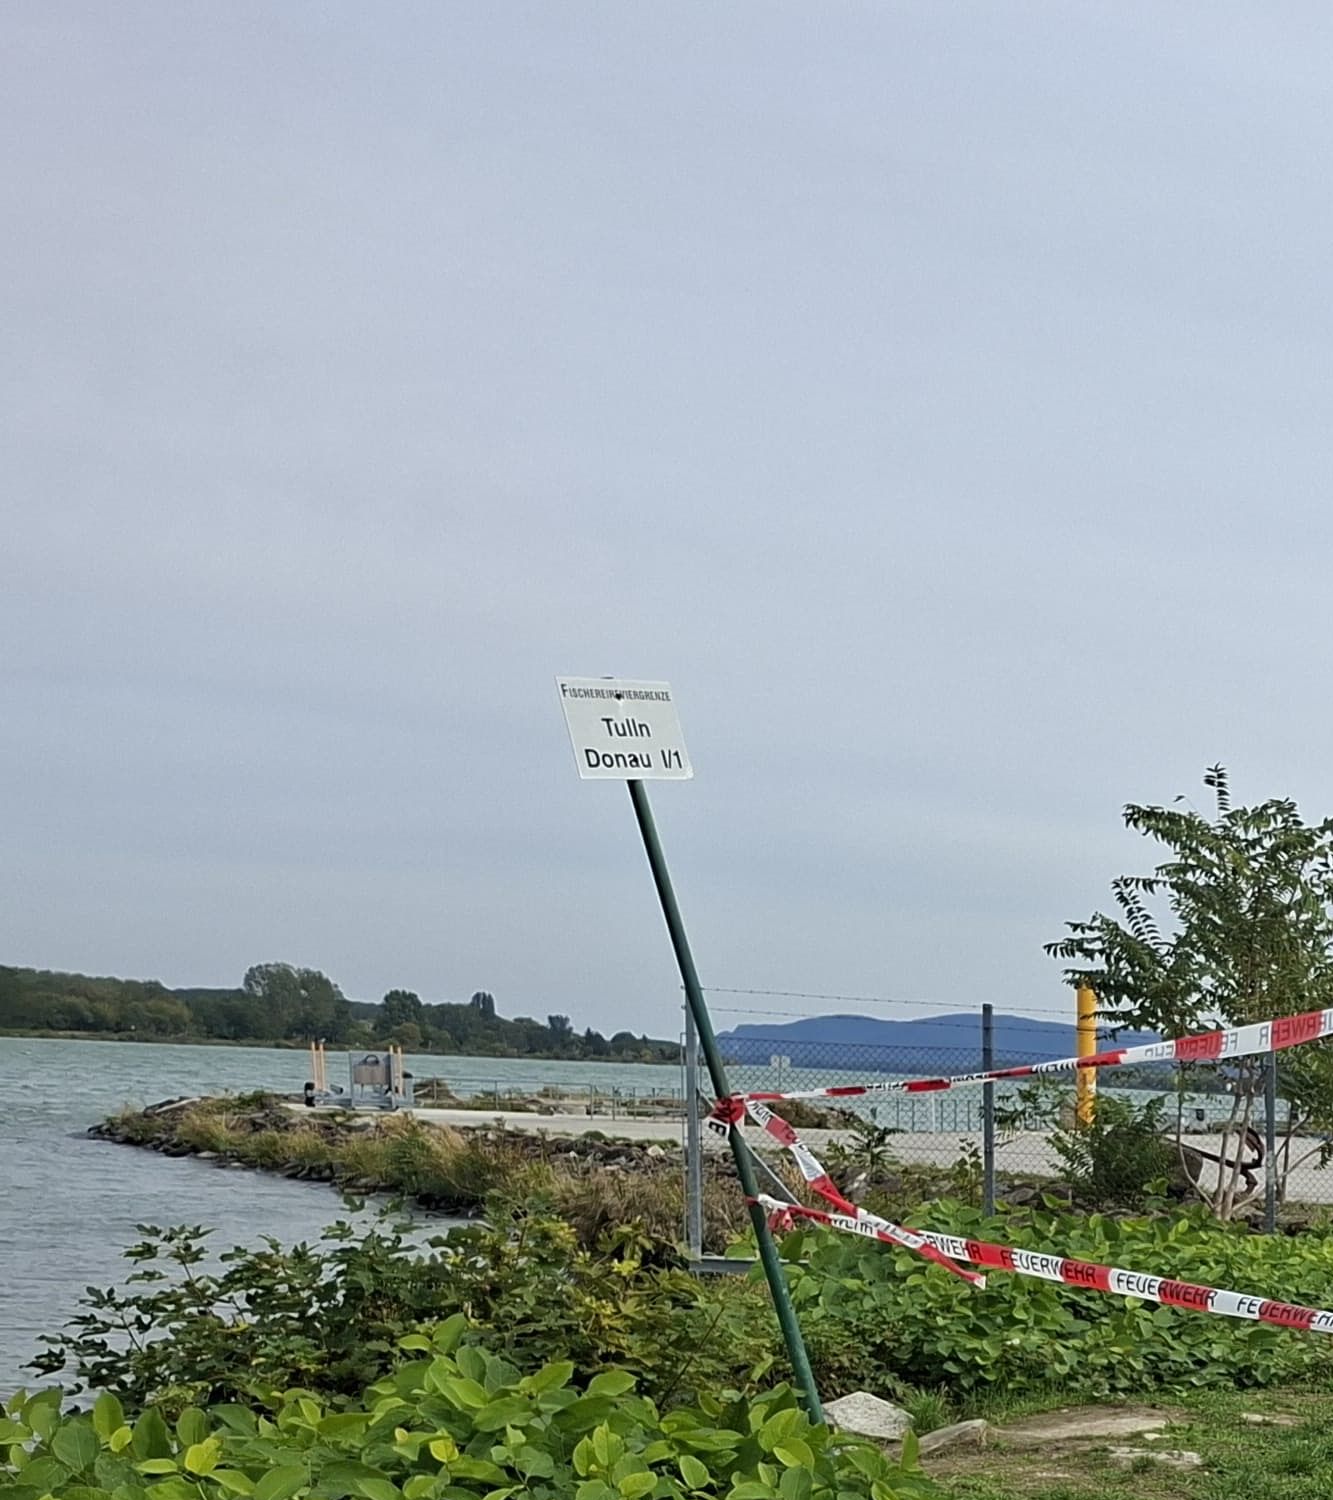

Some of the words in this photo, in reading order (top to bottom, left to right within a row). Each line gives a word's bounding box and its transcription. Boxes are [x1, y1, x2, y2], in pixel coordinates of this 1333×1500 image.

[601, 718, 651, 737] Tulln
[584, 749, 652, 769] Donau
[1000, 1250, 1096, 1284] FEUERWEHR
[1116, 1272, 1217, 1307] FEUERWEHR
